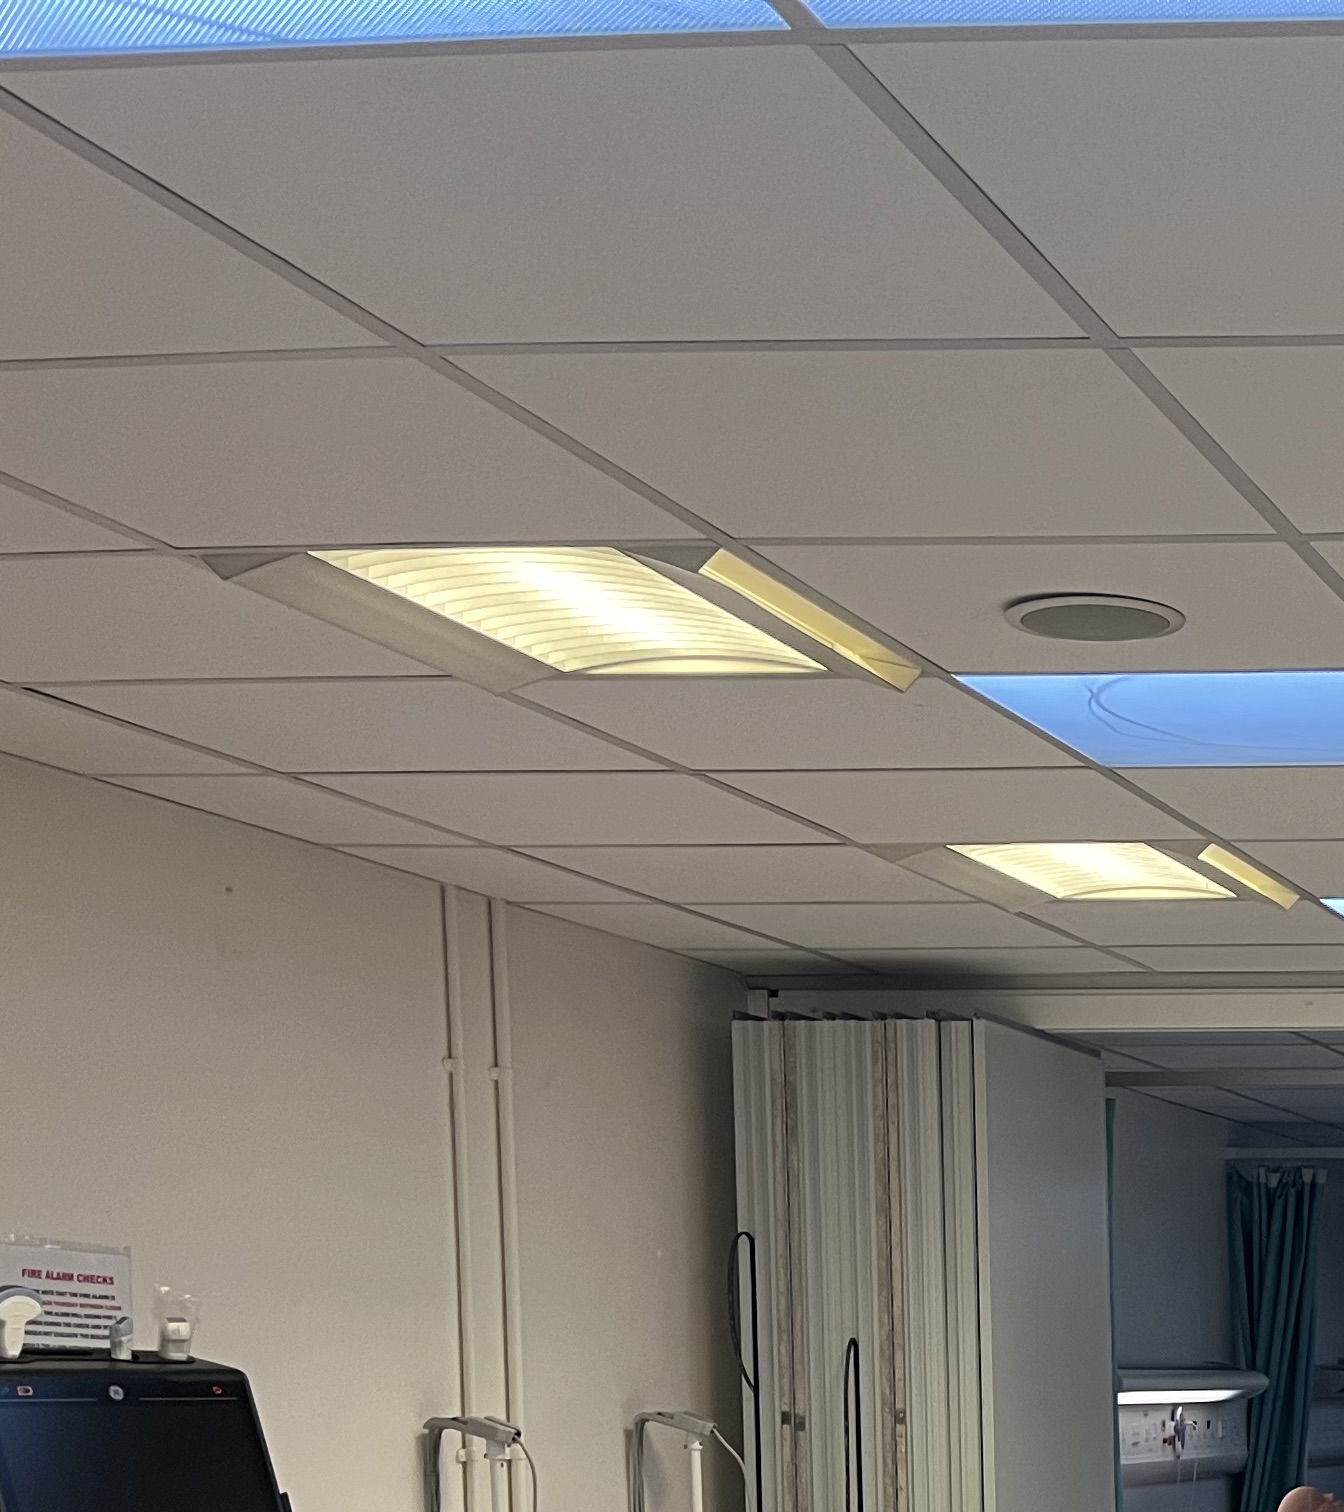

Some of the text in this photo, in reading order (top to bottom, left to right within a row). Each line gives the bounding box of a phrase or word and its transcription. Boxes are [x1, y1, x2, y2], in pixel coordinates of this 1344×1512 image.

[22, 1268, 114, 1285] FIRE ALARM CHECKS
